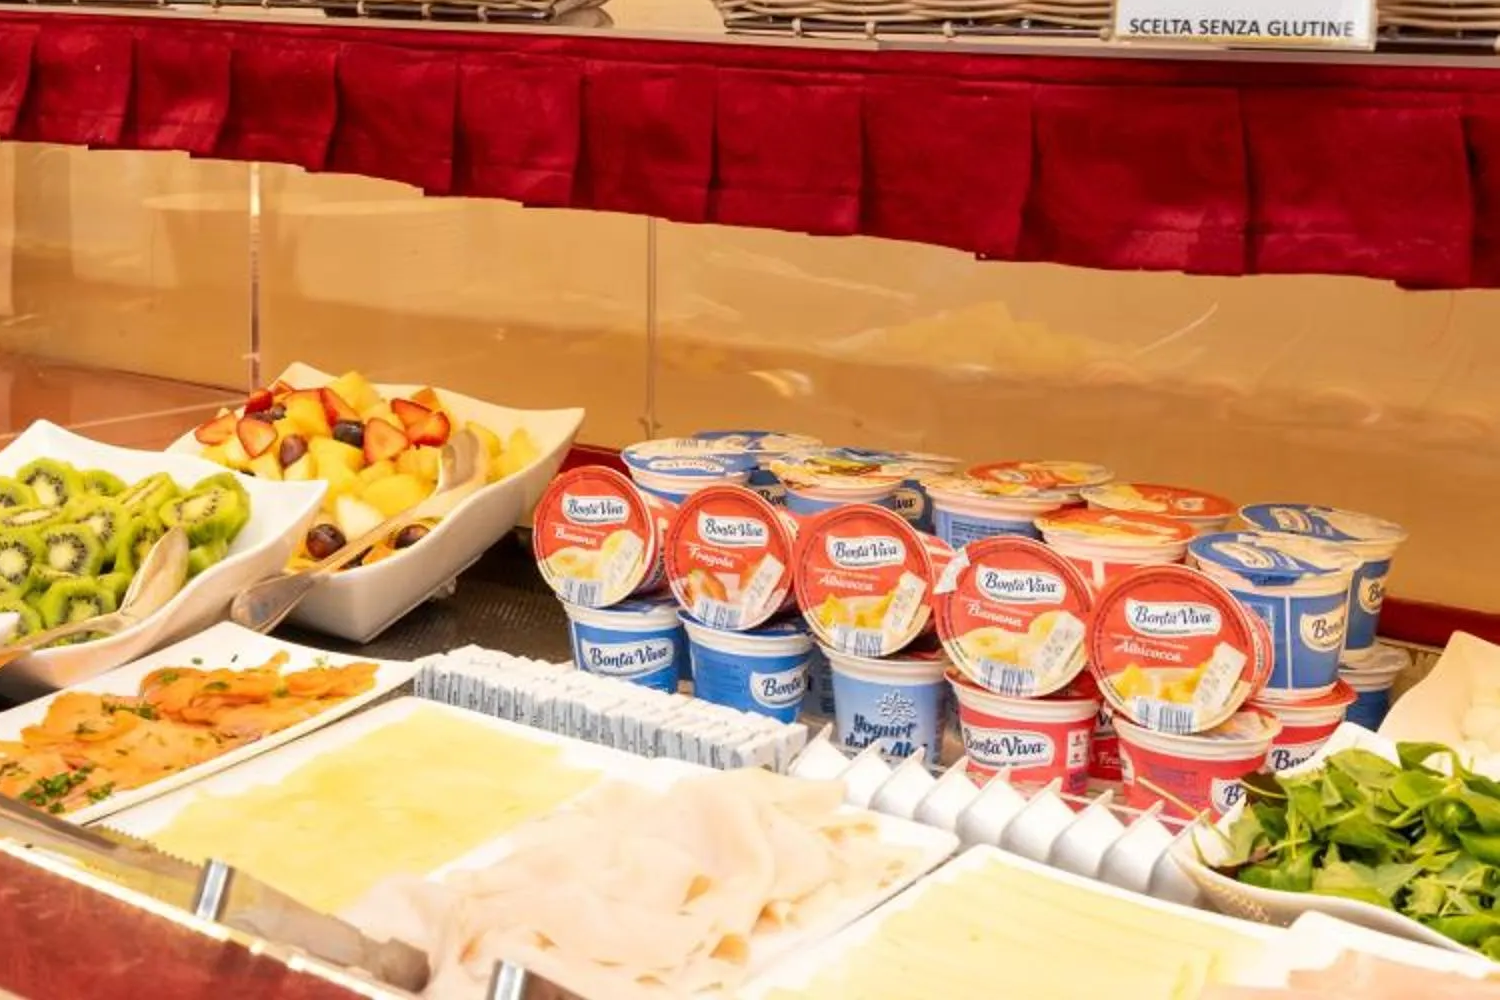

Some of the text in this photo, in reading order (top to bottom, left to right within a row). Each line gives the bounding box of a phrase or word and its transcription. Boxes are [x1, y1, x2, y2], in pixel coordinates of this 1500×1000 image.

[1129, 18, 1355, 38] SCELTA SENZA GLUTINE
[870, 541, 898, 558] Viva
[1025, 575, 1058, 593] Viva
[1177, 606, 1213, 626] Viva
[634, 643, 668, 665] Viva
[853, 712, 917, 739] Yogurt
[1001, 735, 1046, 757] Viva
